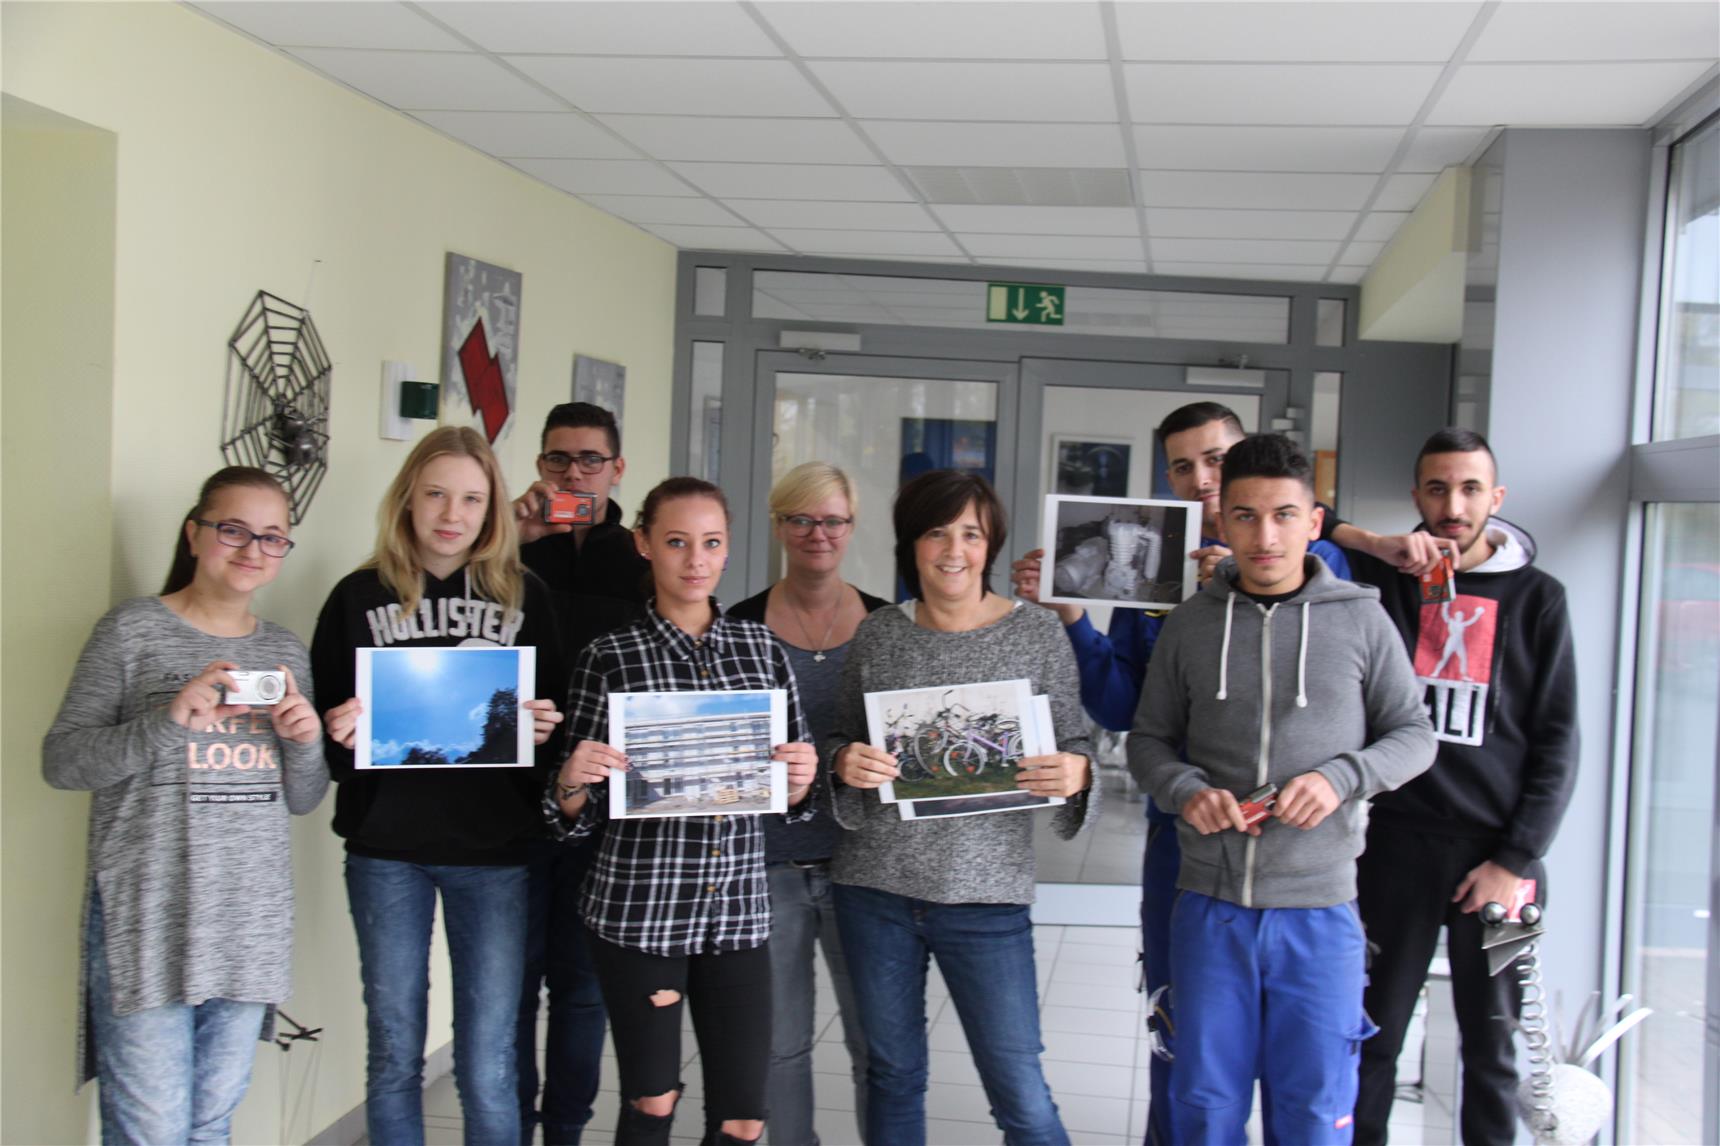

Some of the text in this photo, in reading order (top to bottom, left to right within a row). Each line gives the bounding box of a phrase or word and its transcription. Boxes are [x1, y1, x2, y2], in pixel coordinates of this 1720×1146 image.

[366, 597, 525, 648] HOLLISTER
[1423, 684, 1478, 739] ALI
[187, 742, 278, 769] LOOK
